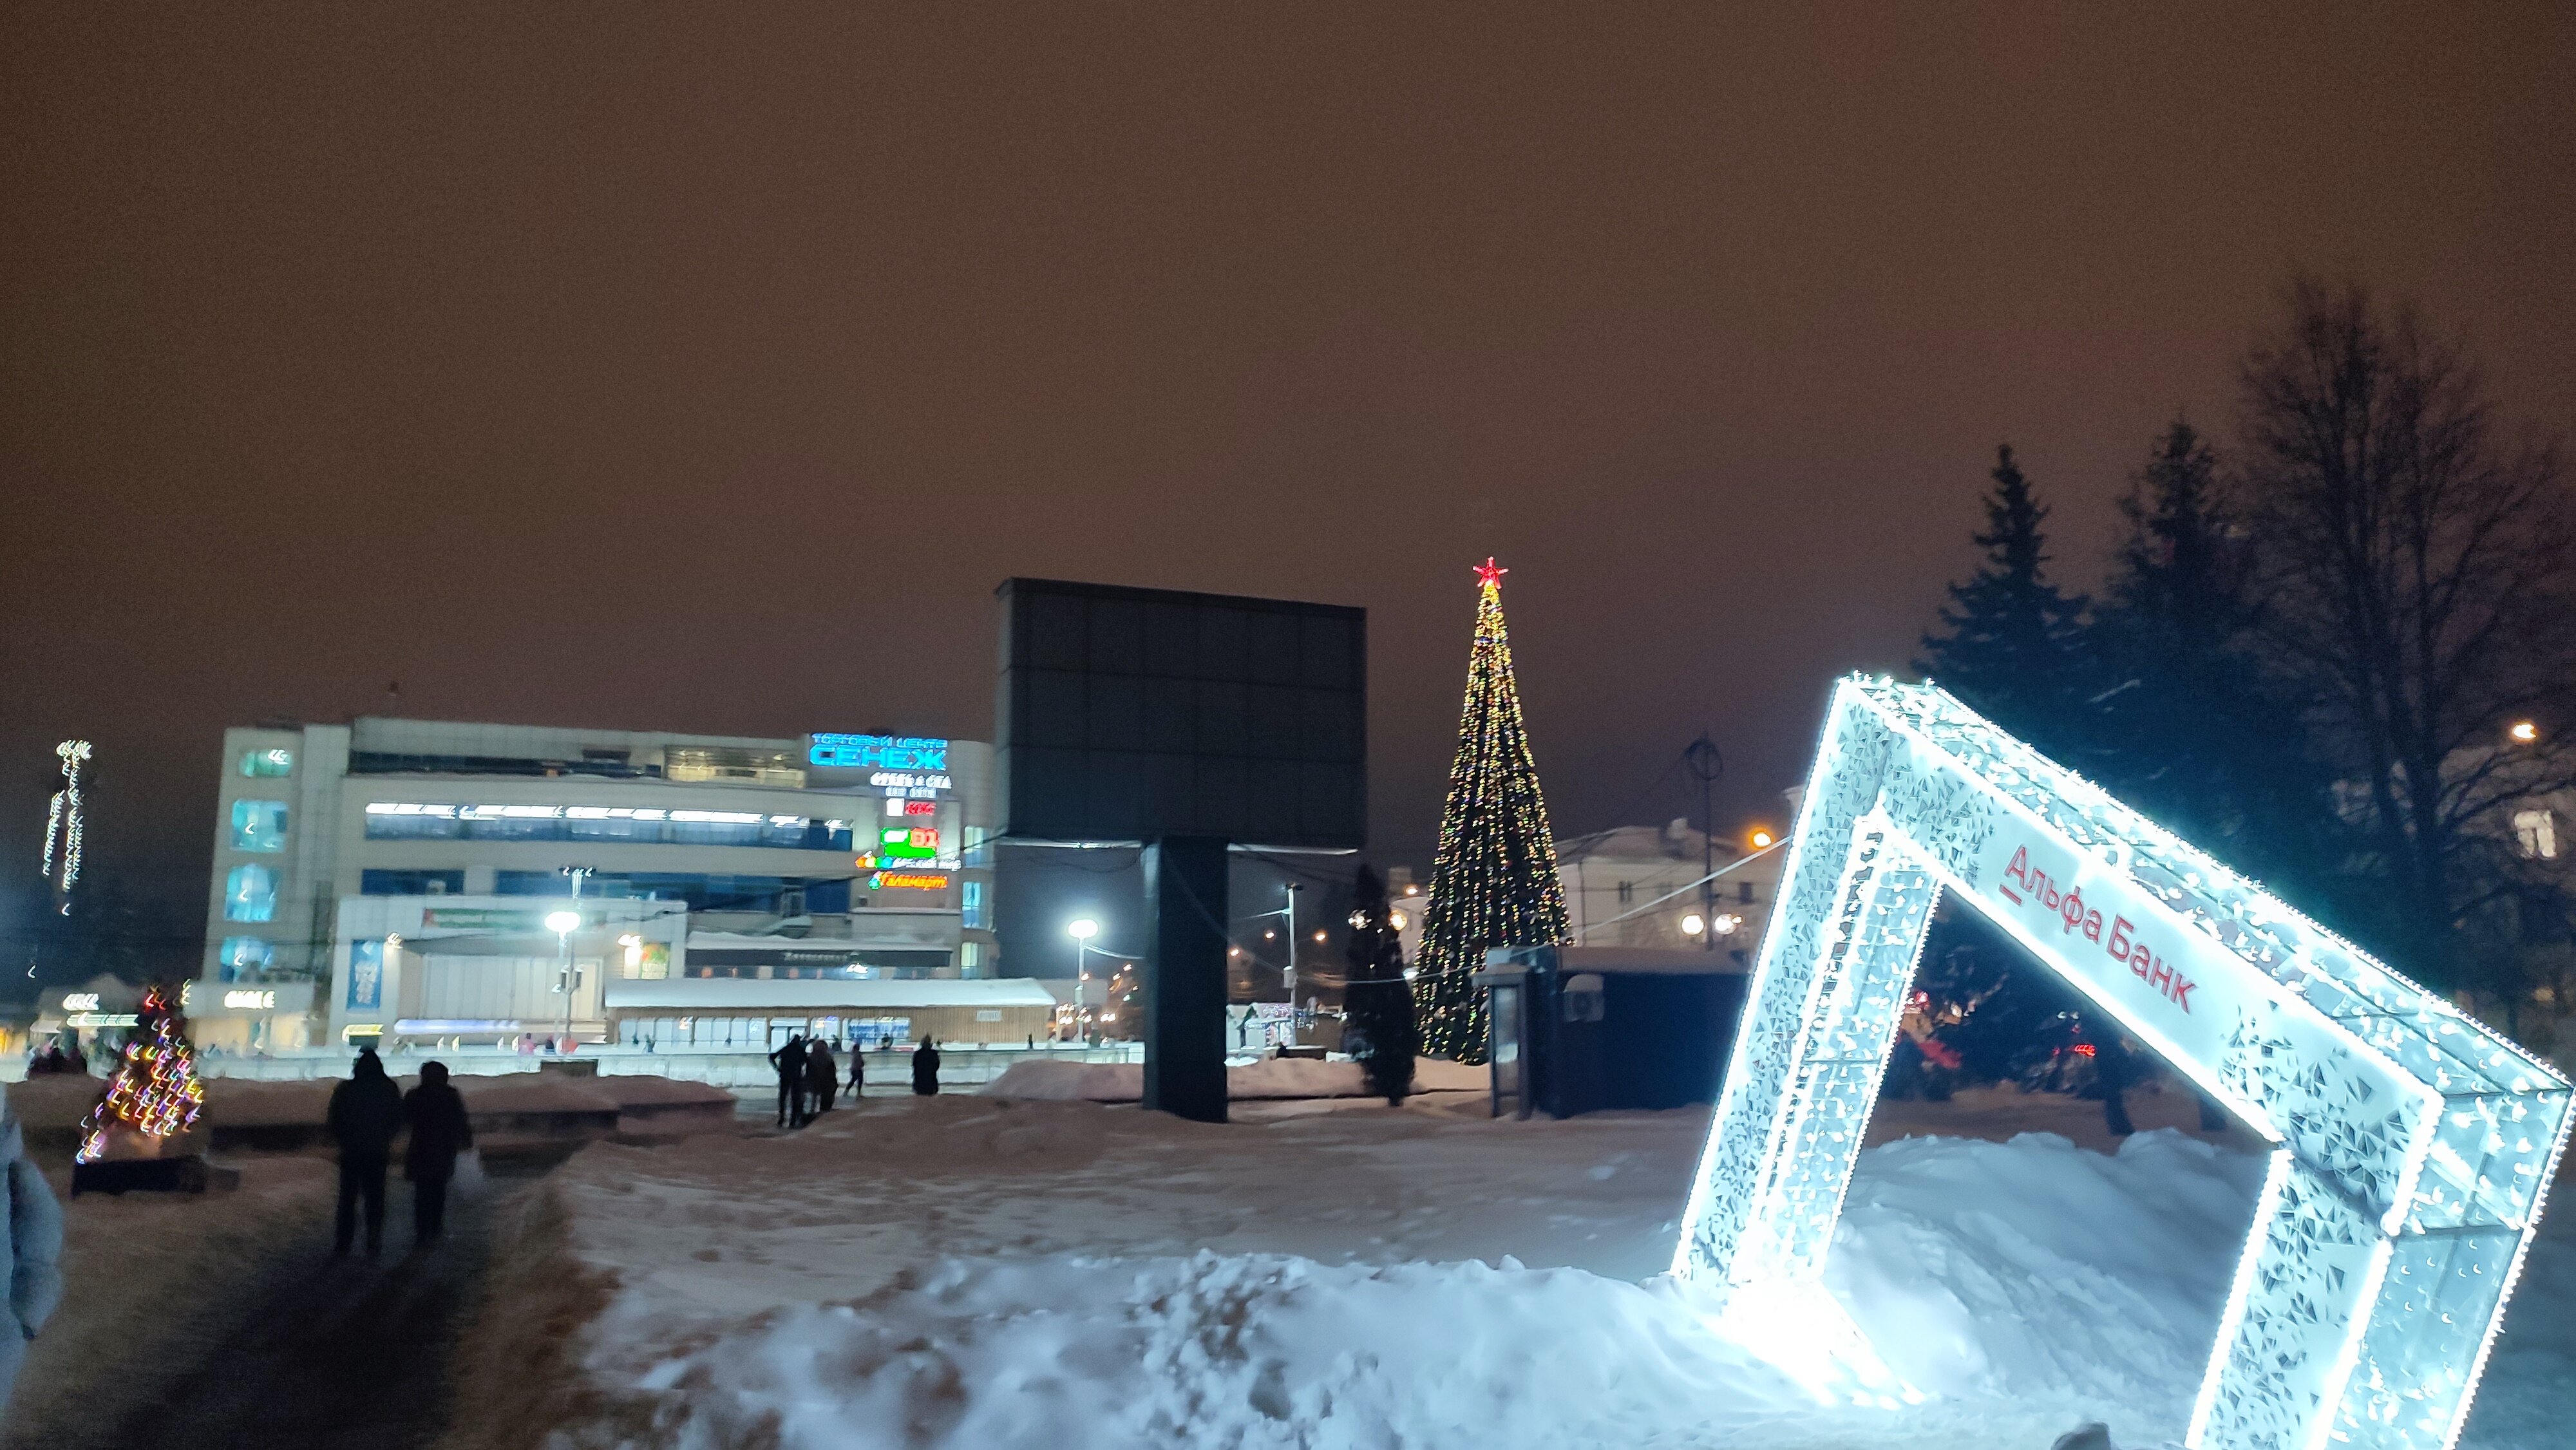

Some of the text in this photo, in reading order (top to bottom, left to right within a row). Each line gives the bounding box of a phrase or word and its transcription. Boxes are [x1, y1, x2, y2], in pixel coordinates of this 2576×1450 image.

[811, 733, 948, 749] ТОРГОВЫЙ ЦЕНТР
[810, 744, 947, 771] СЕНЕЖ
[882, 871, 948, 891] Галамарт
[2002, 845, 2197, 1015] Альфа Банк
